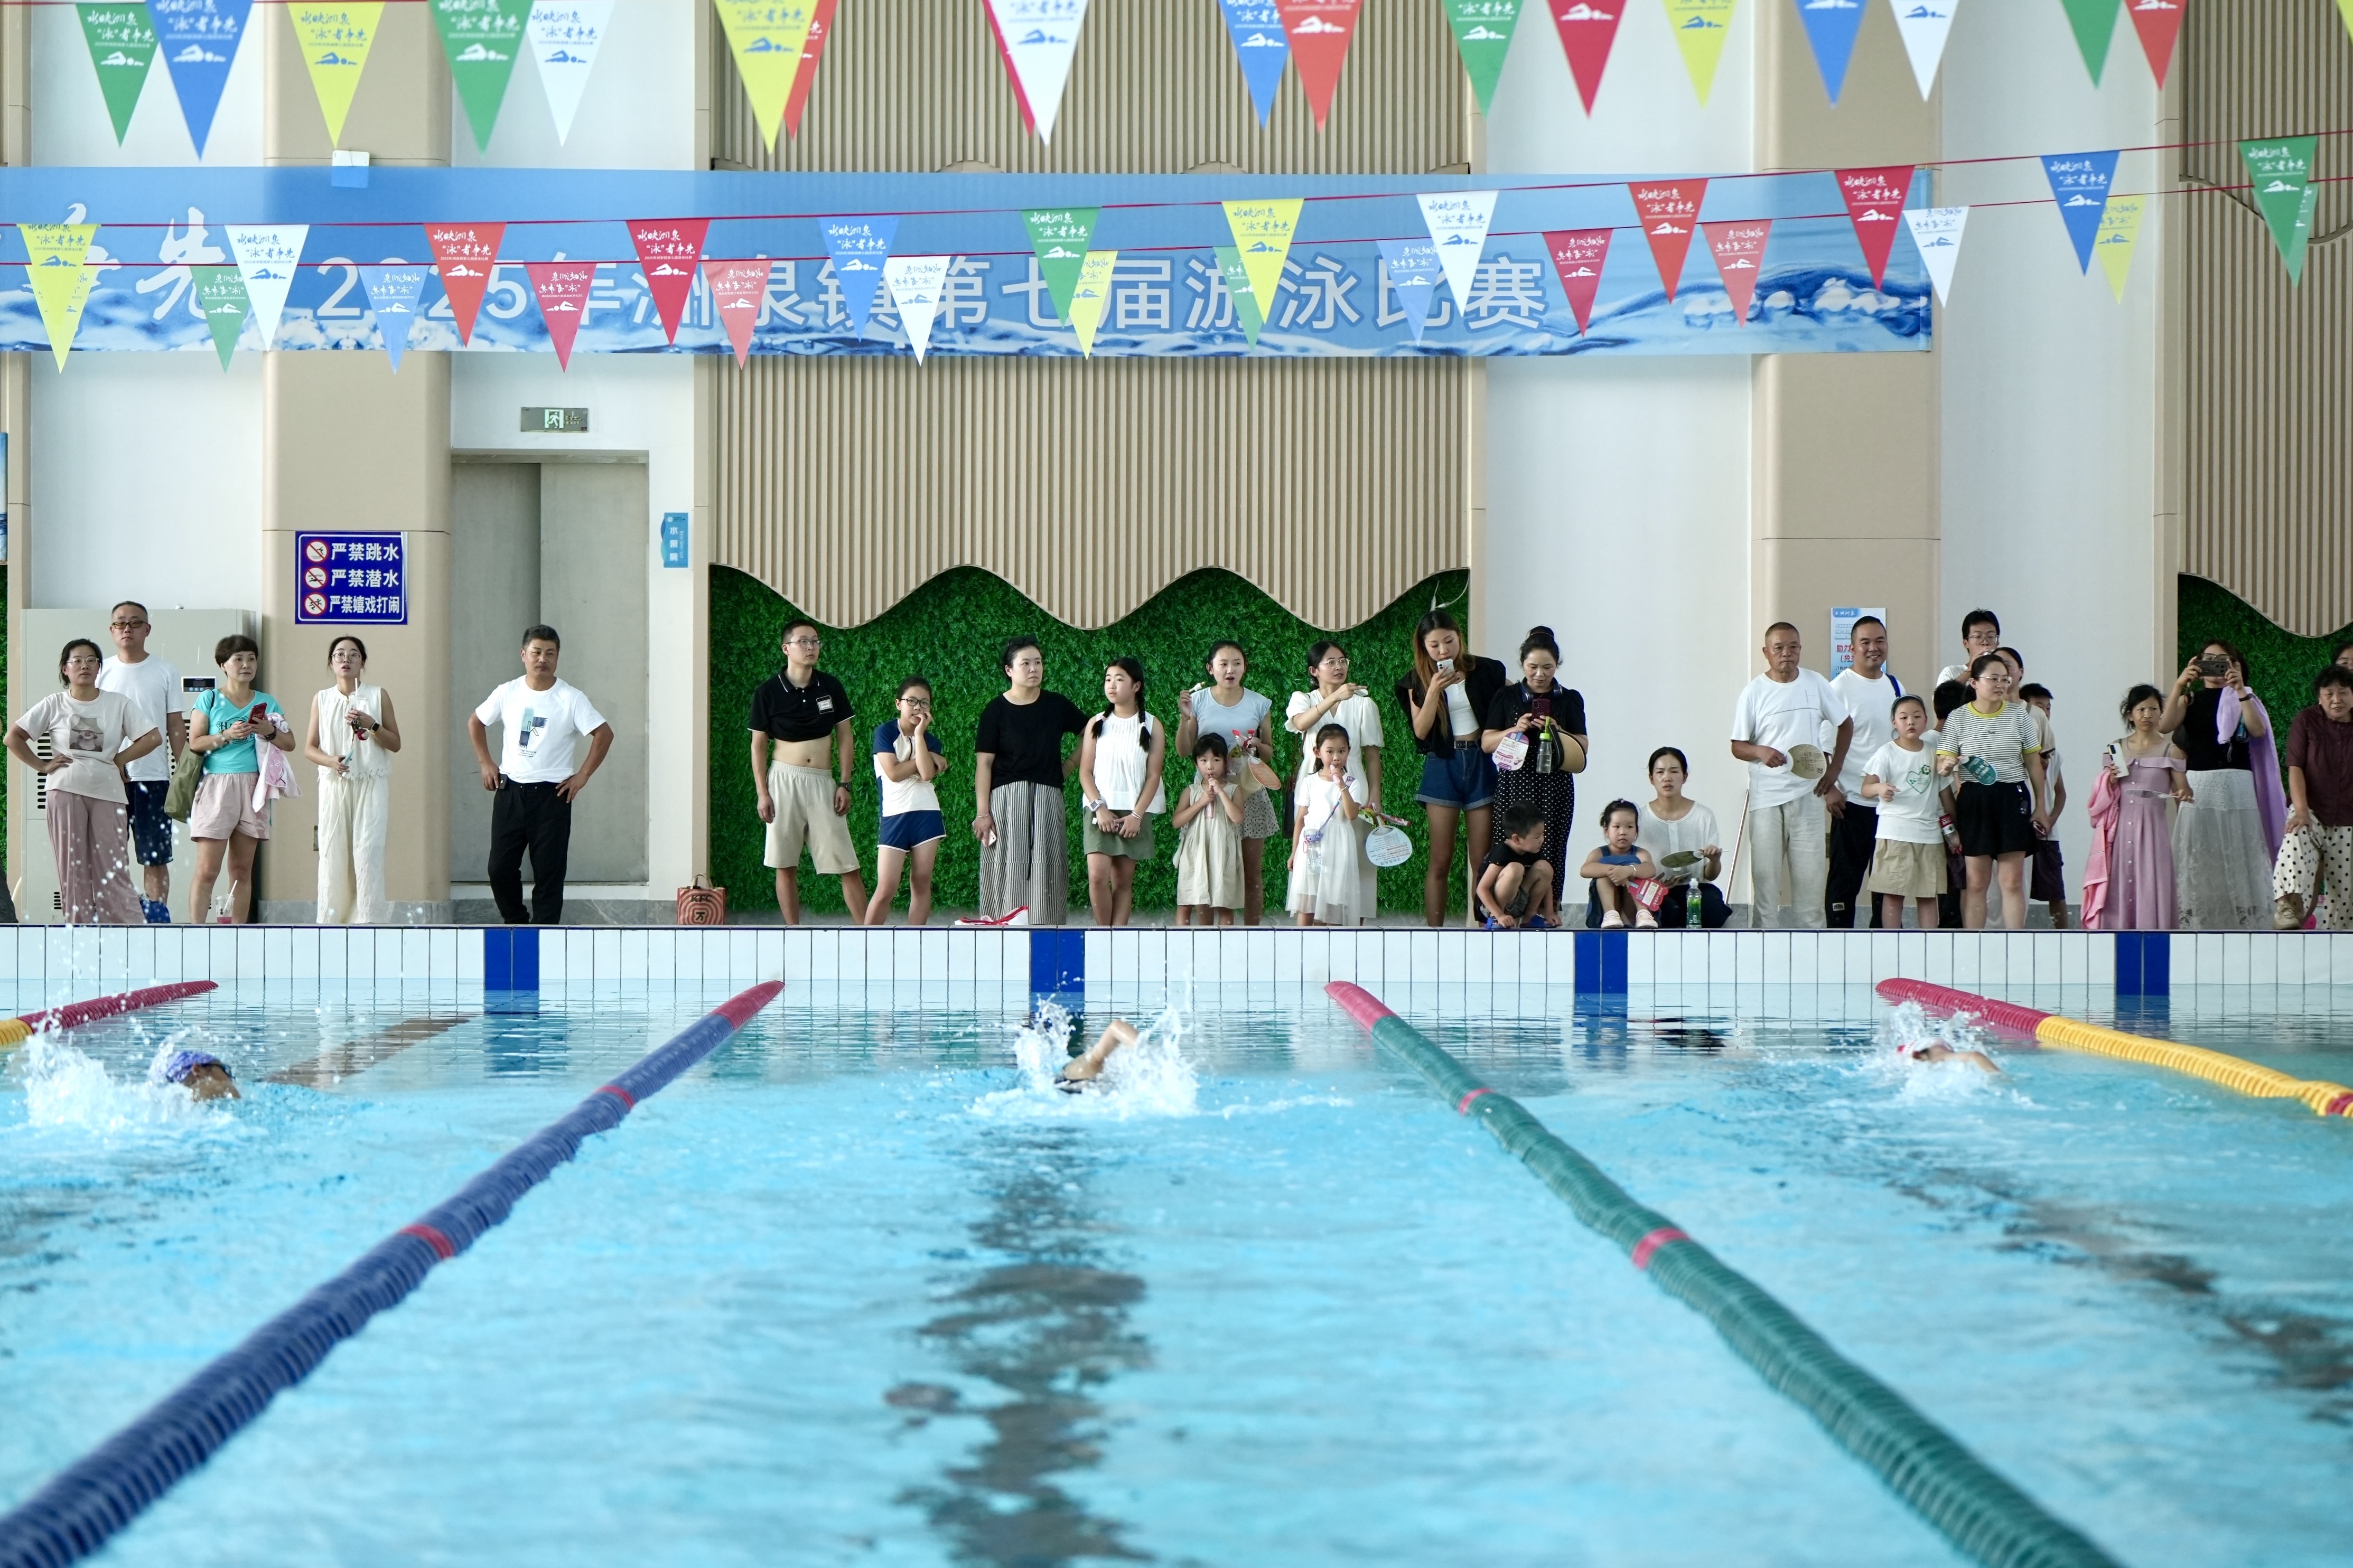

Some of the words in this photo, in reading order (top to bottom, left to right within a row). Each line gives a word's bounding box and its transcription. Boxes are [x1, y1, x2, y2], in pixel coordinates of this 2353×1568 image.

[87, 10, 138, 26] 水映洲泉
[300, 11, 351, 25] 水映洲泉
[531, 9, 582, 24] 水映洲泉
[97, 27, 155, 42] “泳”者争先
[310, 28, 368, 42] “泳”者争先
[541, 26, 597, 40] “泳”者争先
[1233, 207, 1276, 218] 水映洲泉
[1428, 200, 1471, 212] 水映洲泉
[1030, 212, 1073, 224] 水映洲泉
[1437, 212, 1485, 224] “泳”者争先
[828, 224, 872, 237] 水映洲泉
[1039, 225, 1088, 237] “泳”者争先
[1242, 220, 1290, 232] “泳”者争先
[36, 234, 86, 246] “泳”者争先
[237, 233, 281, 245] 水映洲泉
[433, 229, 477, 242] 水映洲泉
[637, 229, 681, 241] 水映洲泉
[442, 243, 491, 256] “泳”者争先
[646, 242, 696, 256] “泳”者争先
[837, 238, 886, 250] “泳”者争先
[246, 247, 295, 259] “泳”者争先
[316, 252, 1545, 330] 25年洲泉镇第七届游泳比赛
[331, 543, 399, 561] 严禁跳水
[331, 569, 399, 588] 严禁潜水
[329, 595, 400, 614] 严禁嬉戏打闹
[690, 894, 713, 903] KFC
